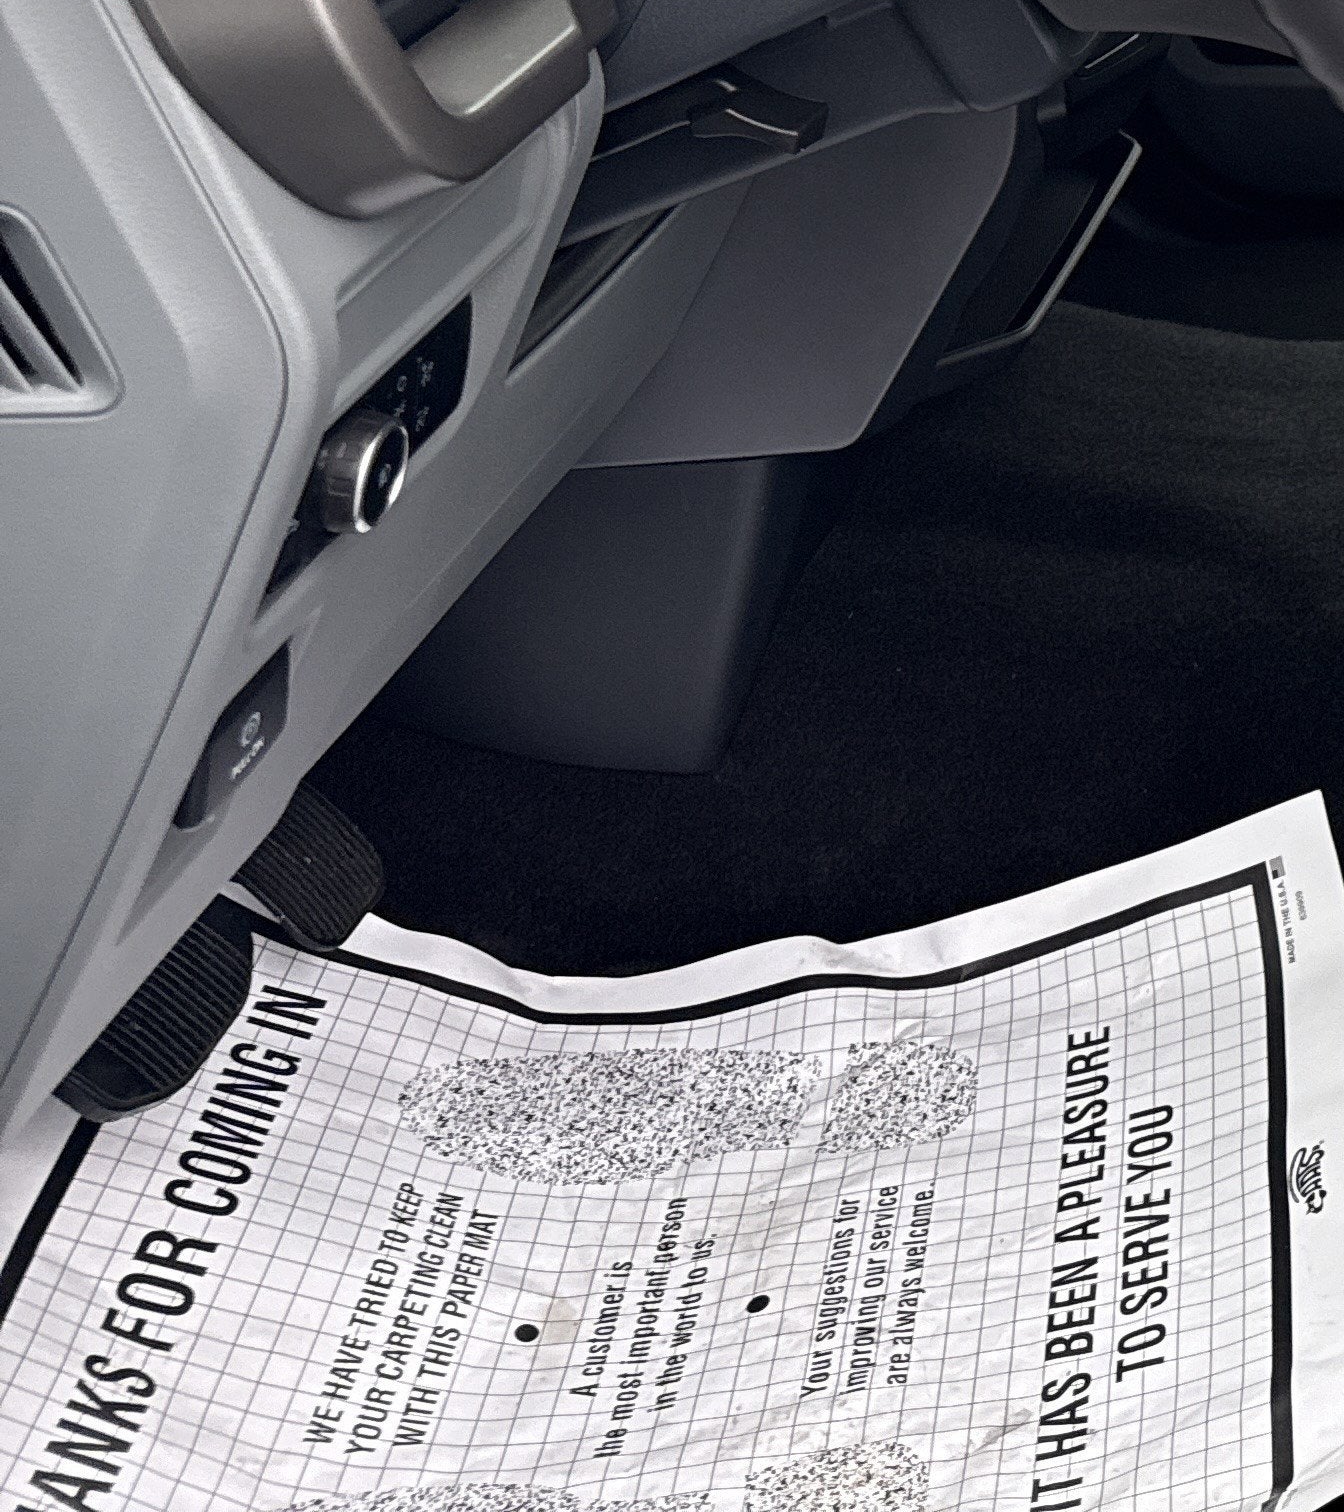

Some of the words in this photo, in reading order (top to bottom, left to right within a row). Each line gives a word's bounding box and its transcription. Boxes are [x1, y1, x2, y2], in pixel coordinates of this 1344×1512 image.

[1280, 907, 1292, 927] THE
[1284, 926, 1293, 938] IN
[1285, 938, 1296, 965] MADE
[1057, 1025, 1111, 1214] PLEASURE
[1126, 1103, 1174, 1186] YOU
[388, 1182, 424, 1228] KEEP
[462, 1208, 499, 1251] MAT
[833, 1198, 861, 1224] for
[869, 1185, 901, 1251] service
[902, 1180, 937, 1273] welcome.
[1054, 1216, 1102, 1245] A
[14, 1354, 156, 1512] ANKS
[100, 1229, 219, 1352] FOR
[163, 1043, 302, 1217] COMING
[247, 984, 328, 1040] IN
[378, 1229, 409, 1253] TO
[691, 1233, 718, 1261] us.
[1120, 1187, 1172, 1319] SERVE
[348, 1258, 399, 1327] TRIED
[441, 1252, 486, 1318] PAPER
[604, 1260, 633, 1279] is
[680, 1266, 709, 1289] to
[815, 1227, 856, 1343] suggestions
[864, 1258, 887, 1288] our
[344, 1387, 397, 1454] YOUR
[375, 1251, 446, 1381] CARPETING
[423, 1191, 464, 1251] CLEAN
[582, 1284, 626, 1378] customer
[593, 1428, 628, 1459] the
[611, 1370, 644, 1421] most
[653, 1197, 688, 1264] person
[669, 1291, 703, 1348] world
[888, 1277, 926, 1346] always
[1044, 1255, 1099, 1361] BEEN
[321, 1334, 371, 1400] HAVE
[417, 1325, 461, 1377] THIS
[655, 1353, 687, 1387] the
[799, 1350, 834, 1399] Your
[886, 1352, 911, 1385] are
[1116, 1322, 1166, 1384] TO
[569, 1382, 599, 1398] A
[646, 1390, 679, 1414] in
[303, 1405, 344, 1443] WE
[392, 1387, 440, 1447] WITH
[1035, 1371, 1092, 1462] HAS
[1029, 1476, 1084, 1512] IT
